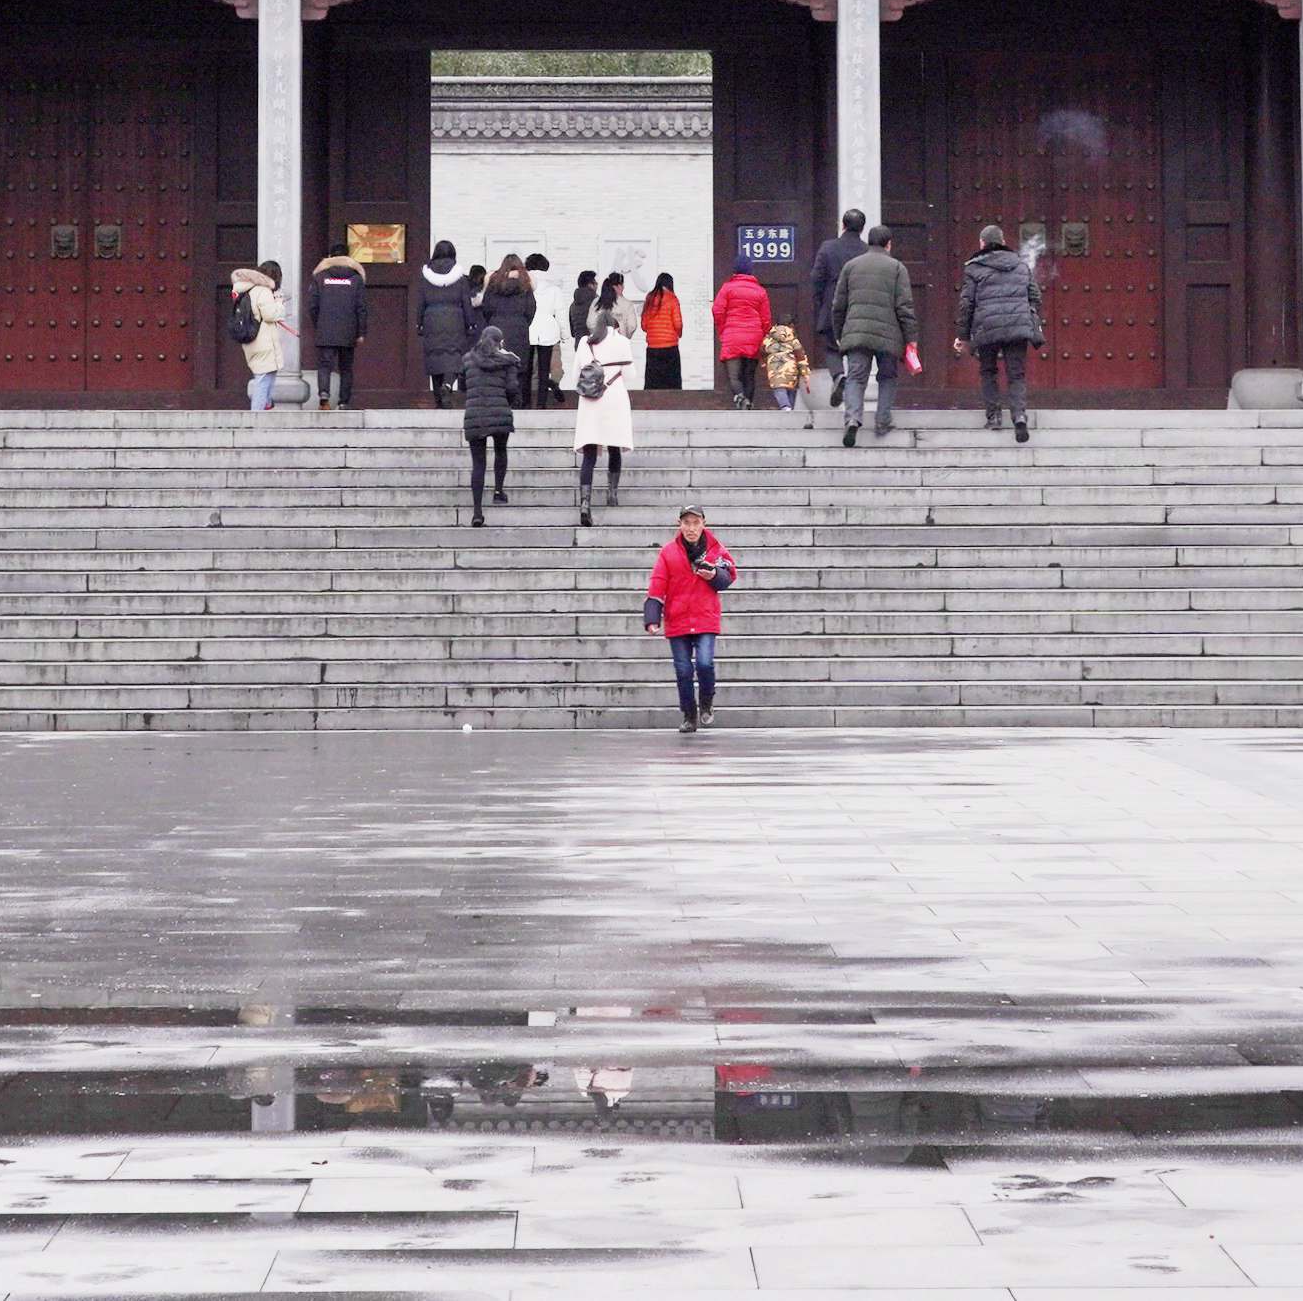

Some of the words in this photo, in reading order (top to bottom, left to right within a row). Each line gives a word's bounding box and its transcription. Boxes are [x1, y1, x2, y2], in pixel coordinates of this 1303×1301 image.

[744, 228, 790, 239] 五乡东路
[742, 242, 791, 258] 1999
